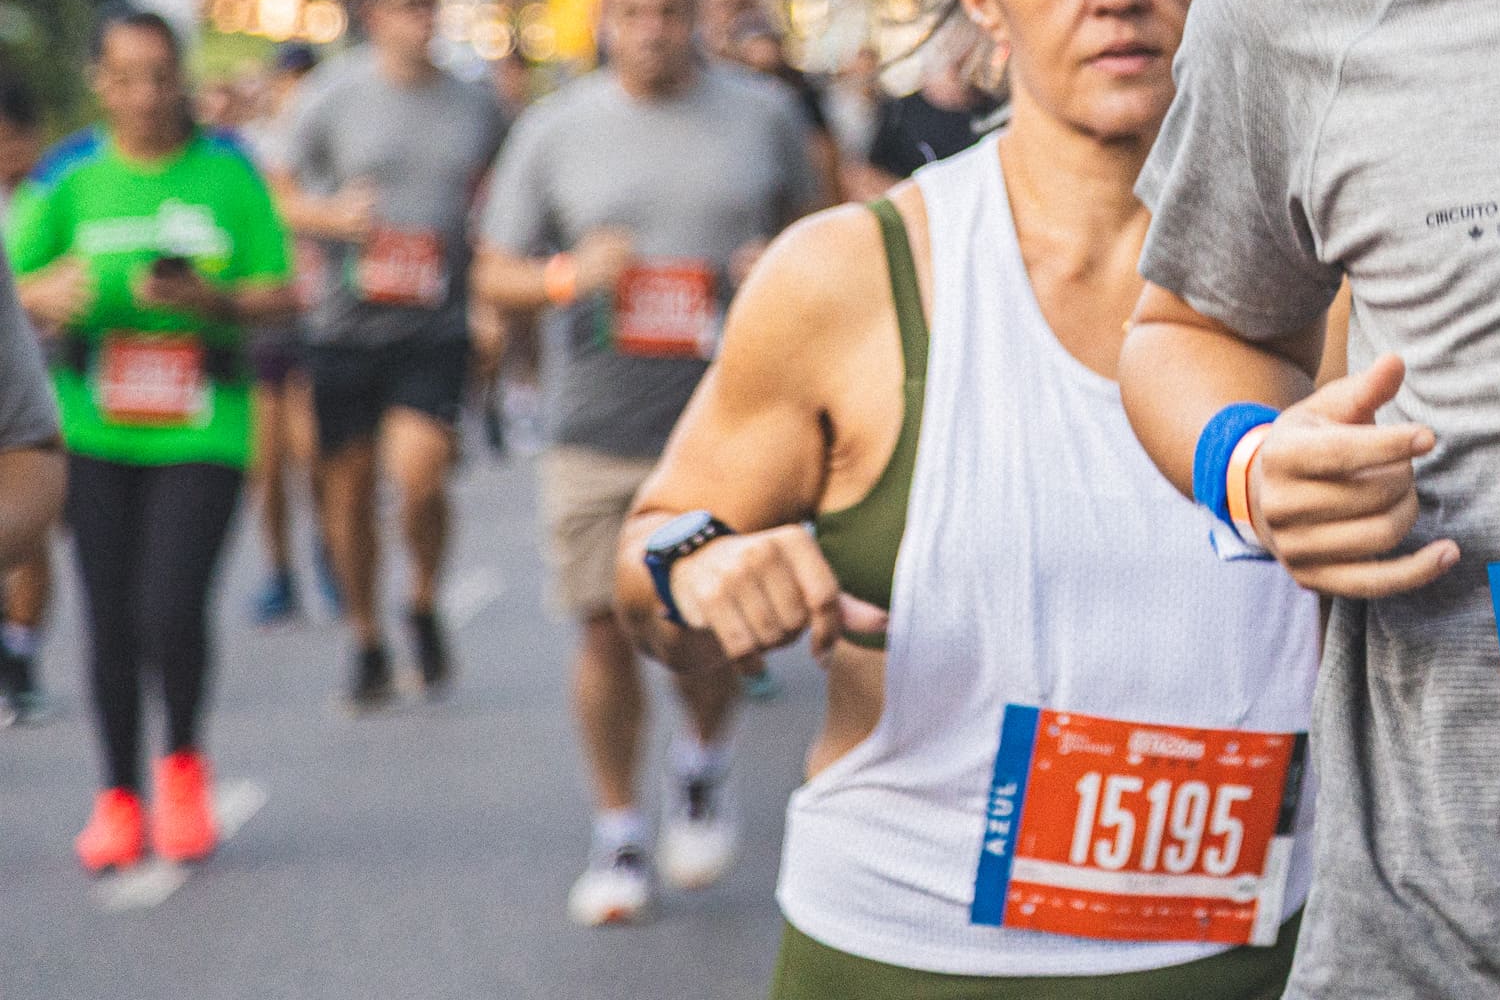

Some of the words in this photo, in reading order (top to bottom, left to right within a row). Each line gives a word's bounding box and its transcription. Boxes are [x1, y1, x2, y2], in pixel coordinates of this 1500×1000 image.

[1426, 202, 1498, 228] CIRCUITO
[985, 782, 1018, 856] AZUL
[1068, 771, 1253, 876] 15195
